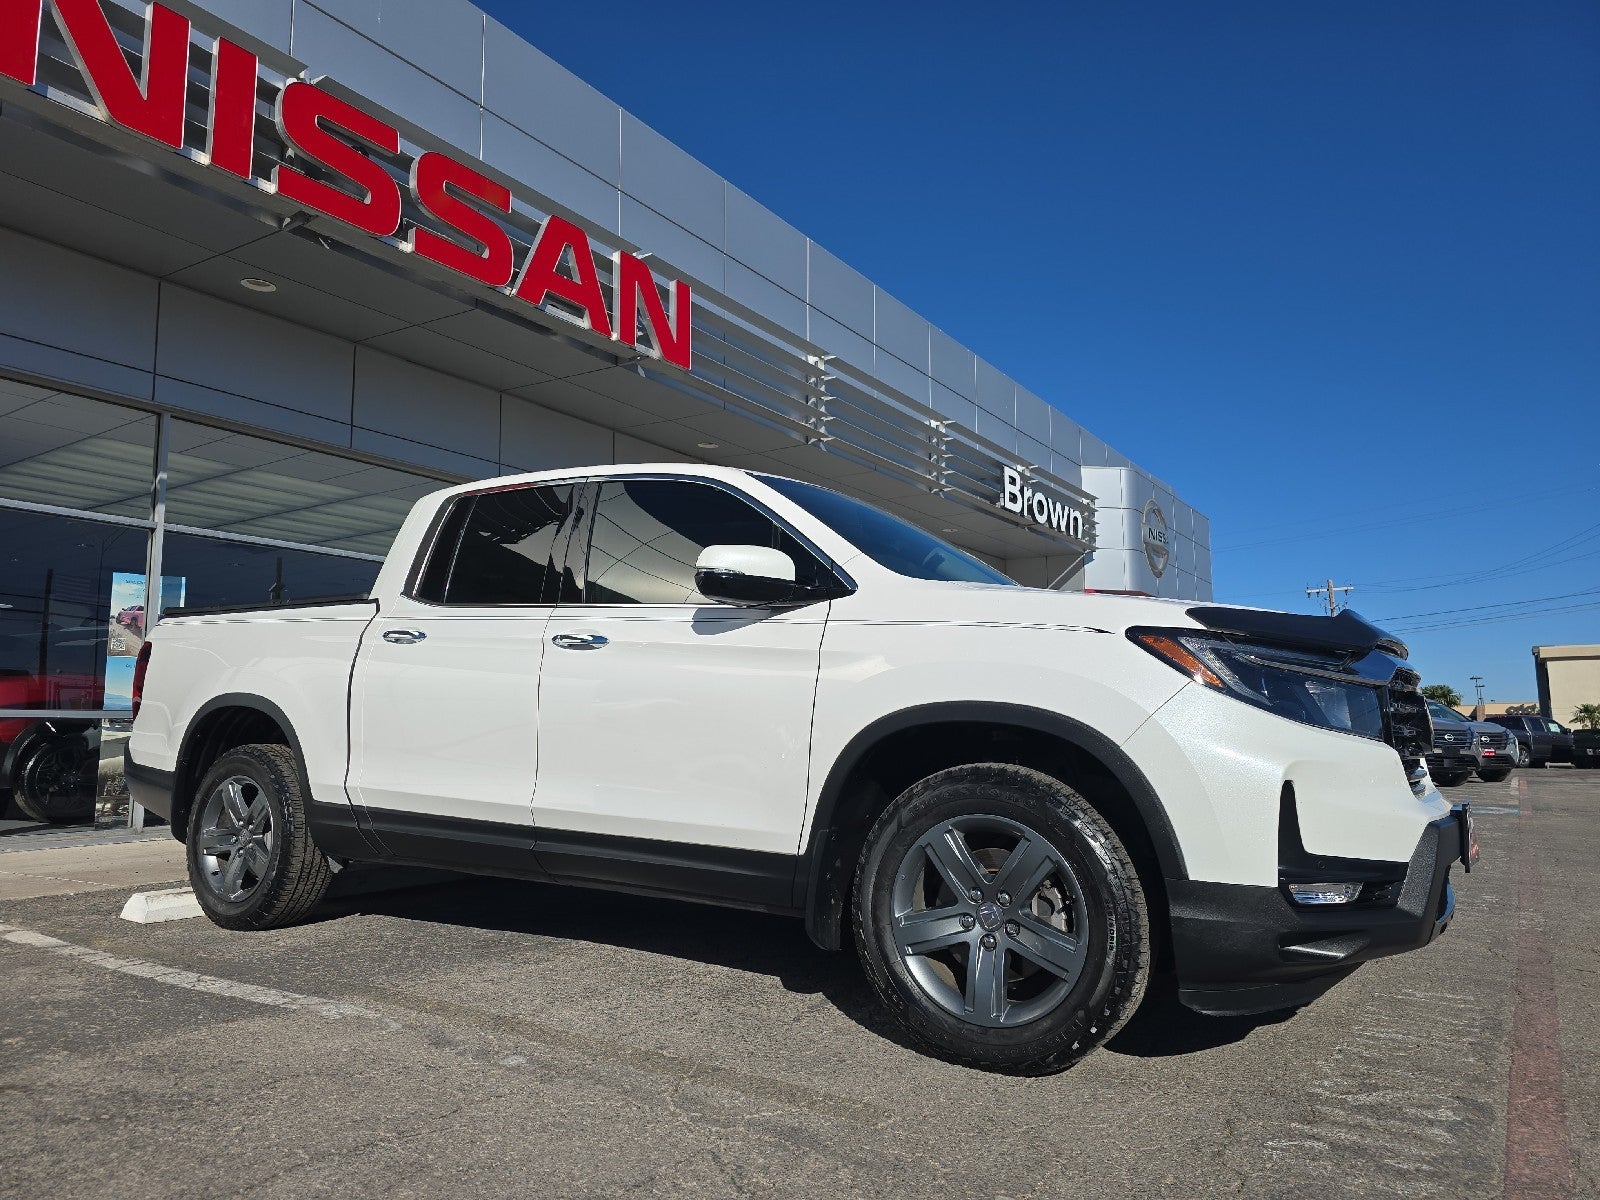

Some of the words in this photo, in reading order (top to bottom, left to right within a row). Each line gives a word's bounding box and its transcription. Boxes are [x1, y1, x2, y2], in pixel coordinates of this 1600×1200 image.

[0, 0, 692, 370] NISSAN
[1003, 465, 1083, 539] Brown
[1148, 527, 1168, 544] NISS
